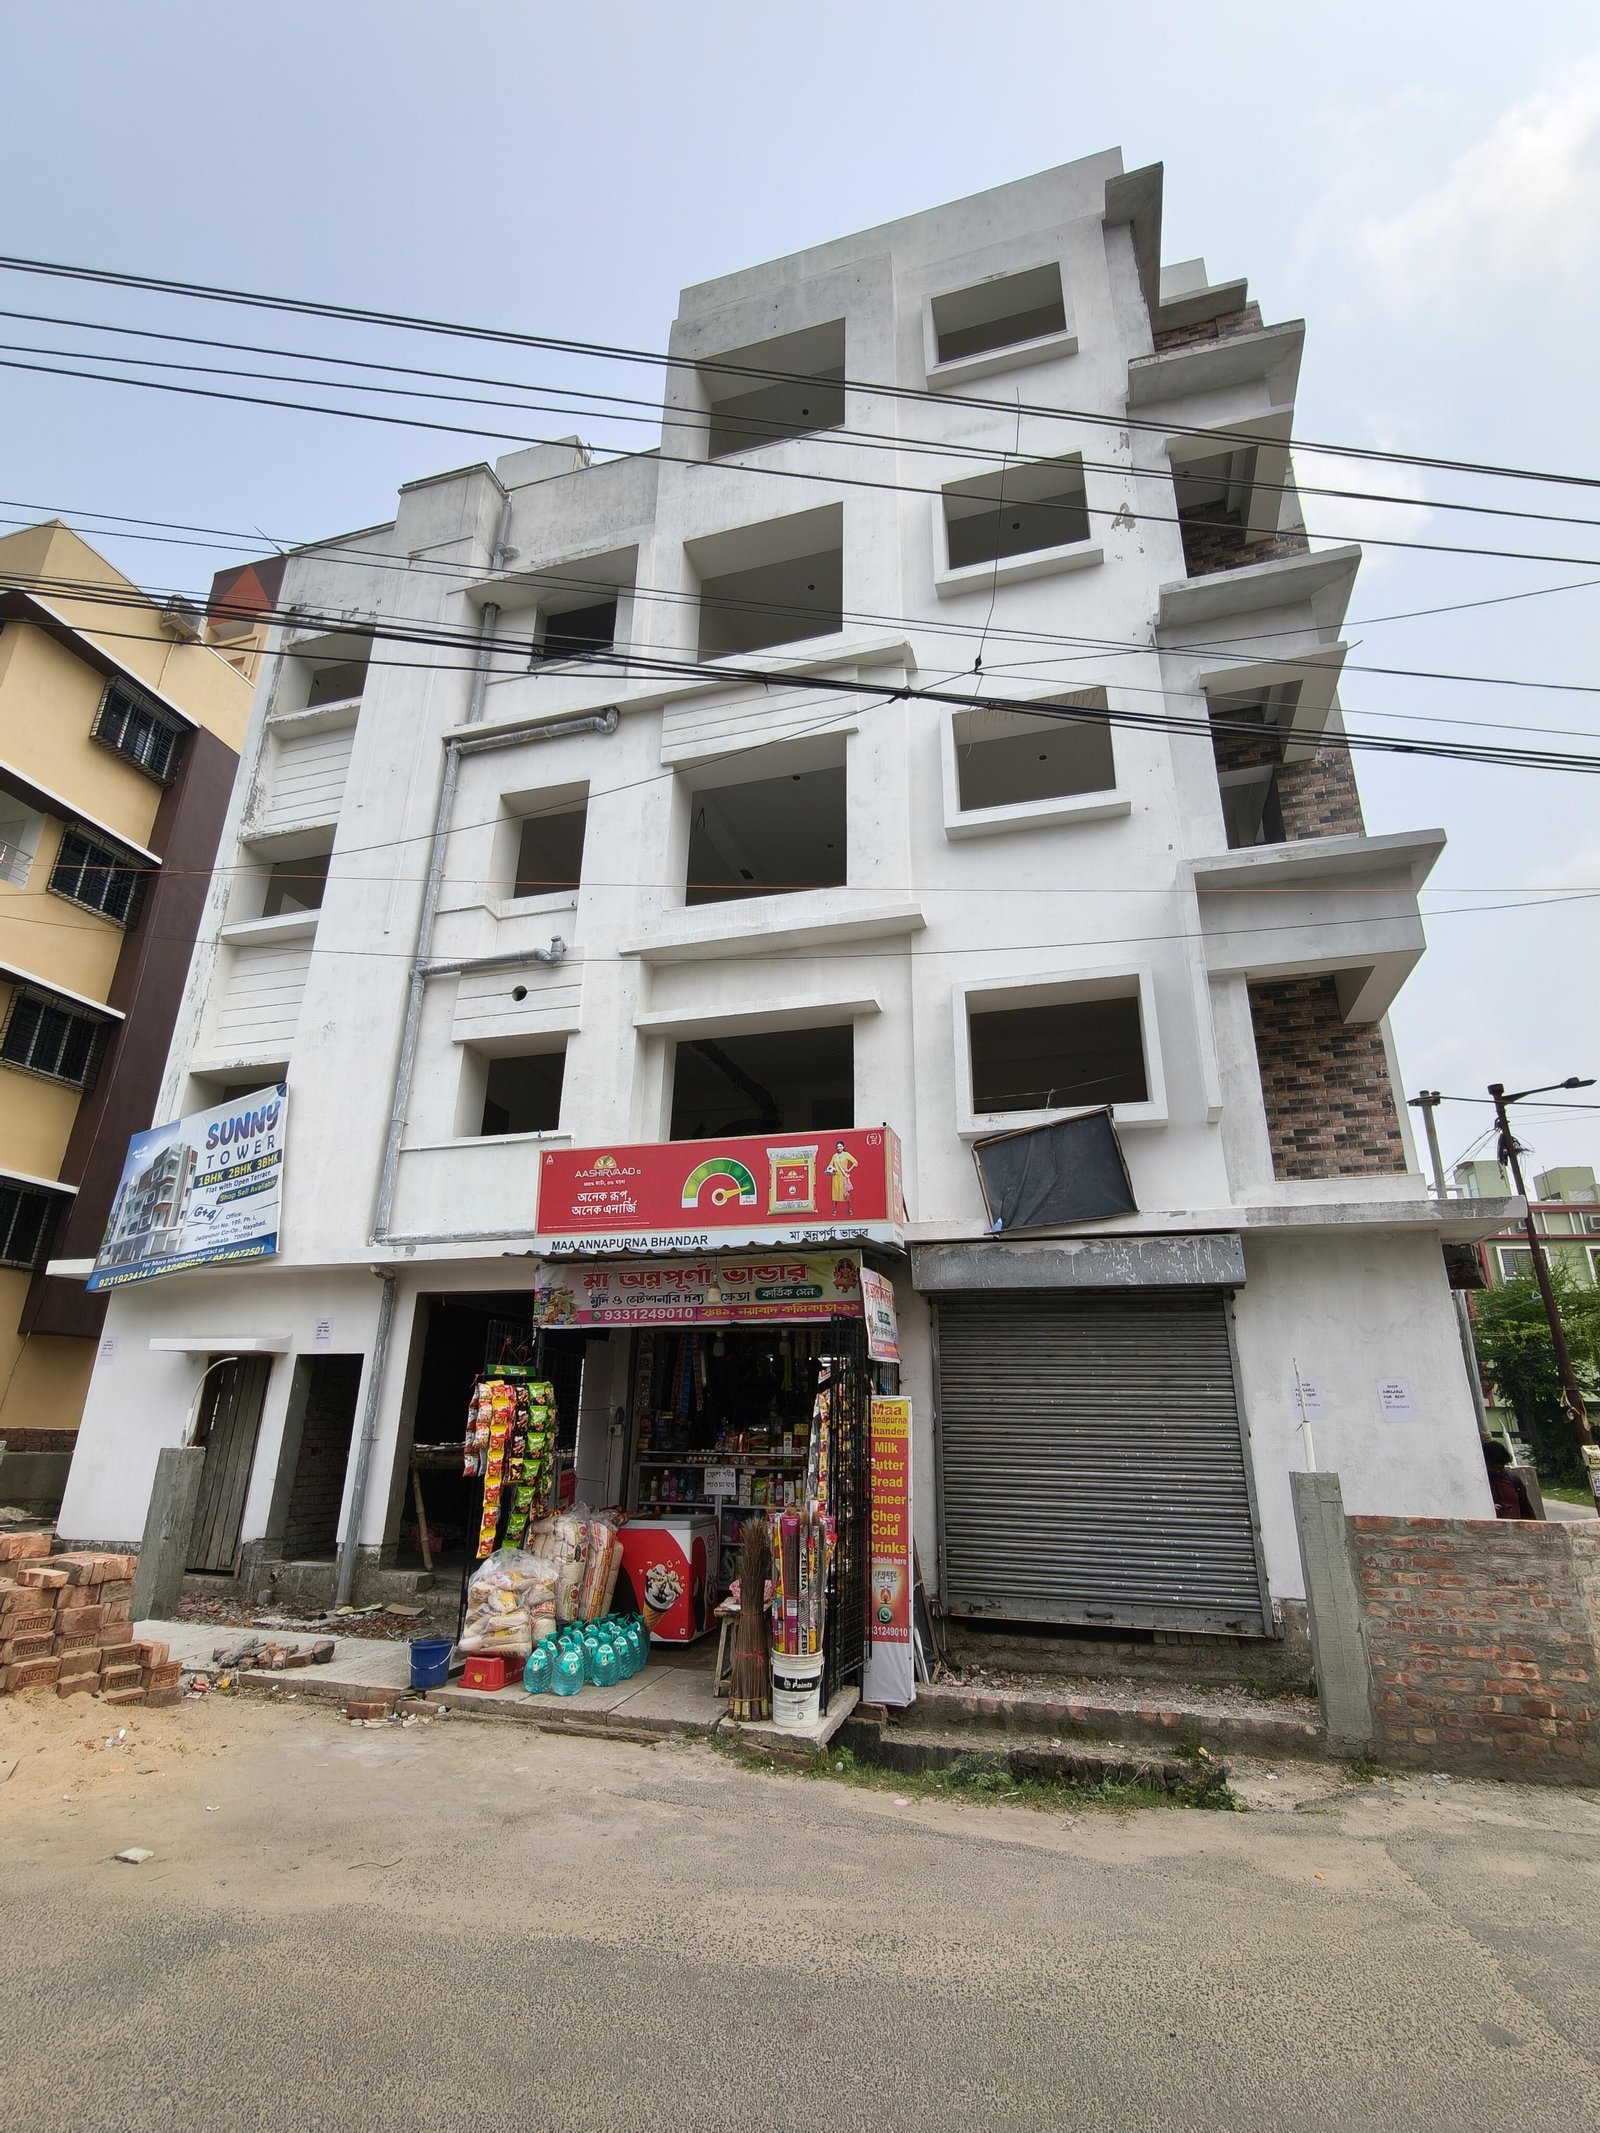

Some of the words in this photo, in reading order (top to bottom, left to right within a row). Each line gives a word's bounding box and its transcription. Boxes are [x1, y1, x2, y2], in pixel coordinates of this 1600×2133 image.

[206, 1101, 281, 1150] SUNNY
[206, 1135, 275, 1169] TOWER
[198, 1172, 224, 1187] 1BHK
[229, 1162, 253, 1178] 2BHK
[257, 1152, 279, 1170] 3BHK
[575, 1168, 635, 1178] AASHIRVAAD
[205, 1185, 217, 1194] Flat
[219, 1181, 232, 1191] with
[234, 1177, 250, 1188] Open
[251, 1170, 271, 1181] Terrace
[577, 1191, 608, 1202] অনেক
[609, 1190, 632, 1202] রূপ,
[194, 1206, 217, 1221] G+4
[571, 1205, 602, 1216] অনেক
[603, 1200, 637, 1214] এনার্জি
[552, 1240, 575, 1251] MAA
[579, 1238, 648, 1250] ANNAPURNA
[651, 1232, 708, 1247] BHANDAR
[789, 1230, 800, 1241] মা
[582, 1271, 610, 1289] মা
[618, 1263, 713, 1293] অন্নপূর্ণা
[762, 1286, 793, 1299] কার্তিক
[795, 1287, 815, 1297] সেন
[612, 1295, 623, 1305] ও
[604, 1307, 694, 1321] 9331249010
[872, 1403, 902, 1416] Maa
[872, 1416, 908, 1425] nnapurna
[871, 1426, 907, 1436] hander
[874, 1441, 899, 1454] Milk
[870, 1475, 903, 1488] Bread
[872, 1492, 907, 1505] aneer
[871, 1509, 901, 1522] Ghee
[871, 1523, 899, 1536] Cold
